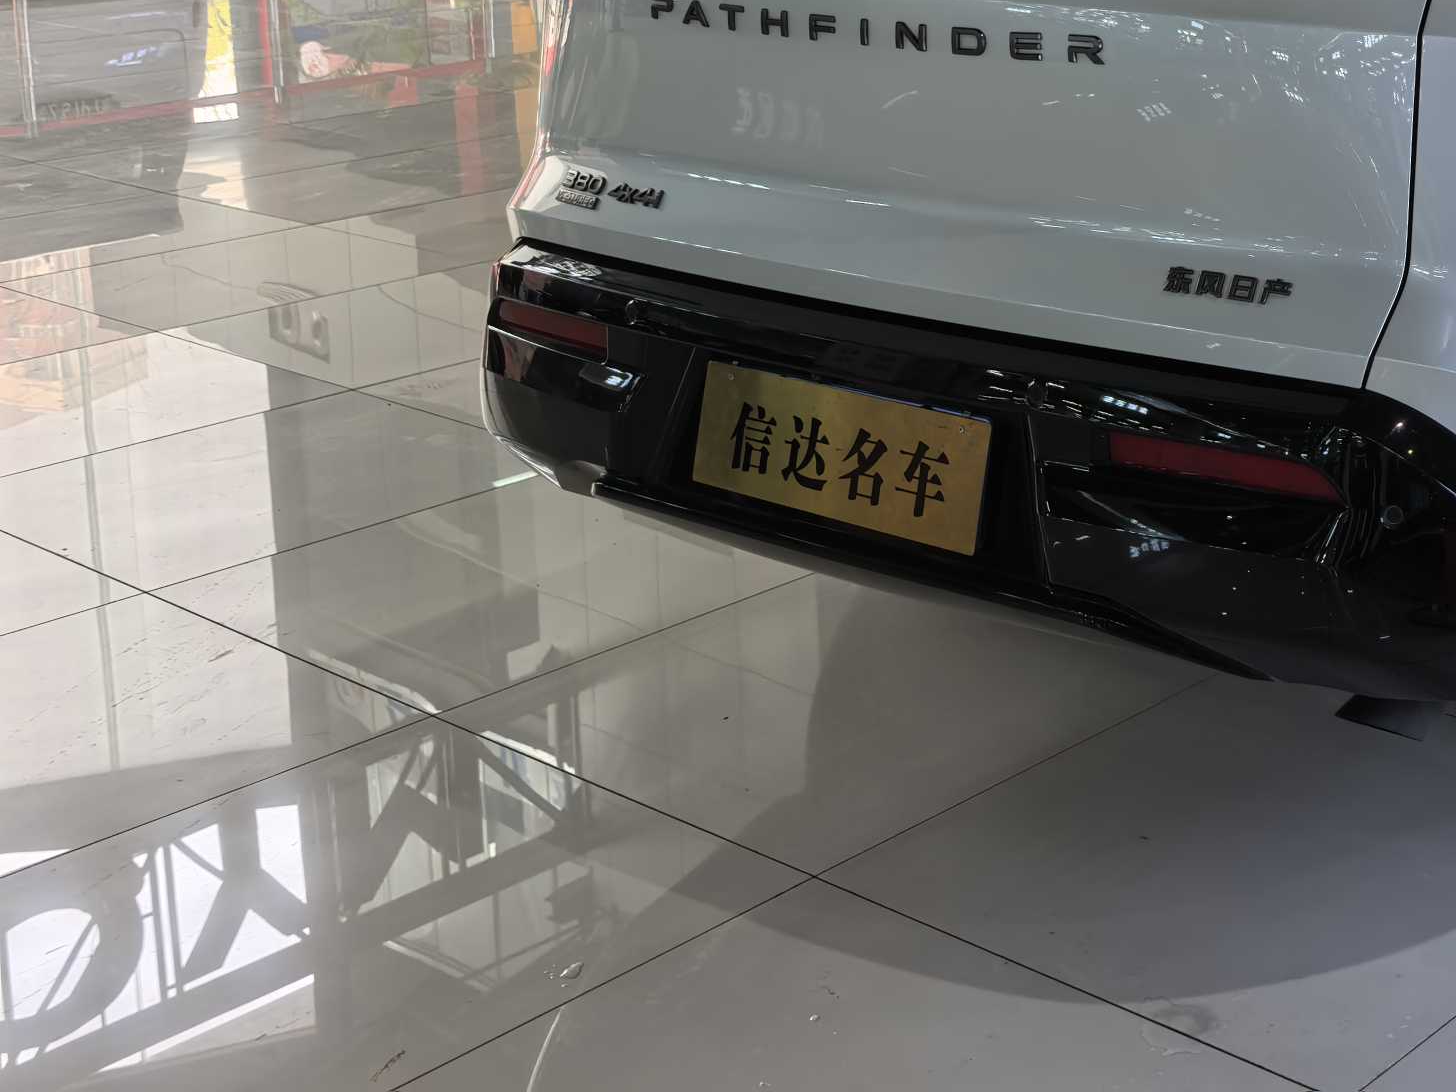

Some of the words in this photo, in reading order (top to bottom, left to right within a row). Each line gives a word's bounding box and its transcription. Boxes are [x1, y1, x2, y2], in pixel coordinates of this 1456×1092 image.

[562, 169, 607, 196] 380
[1163, 266, 1294, 305] 东风日产
[729, 401, 950, 518] 信达名车
